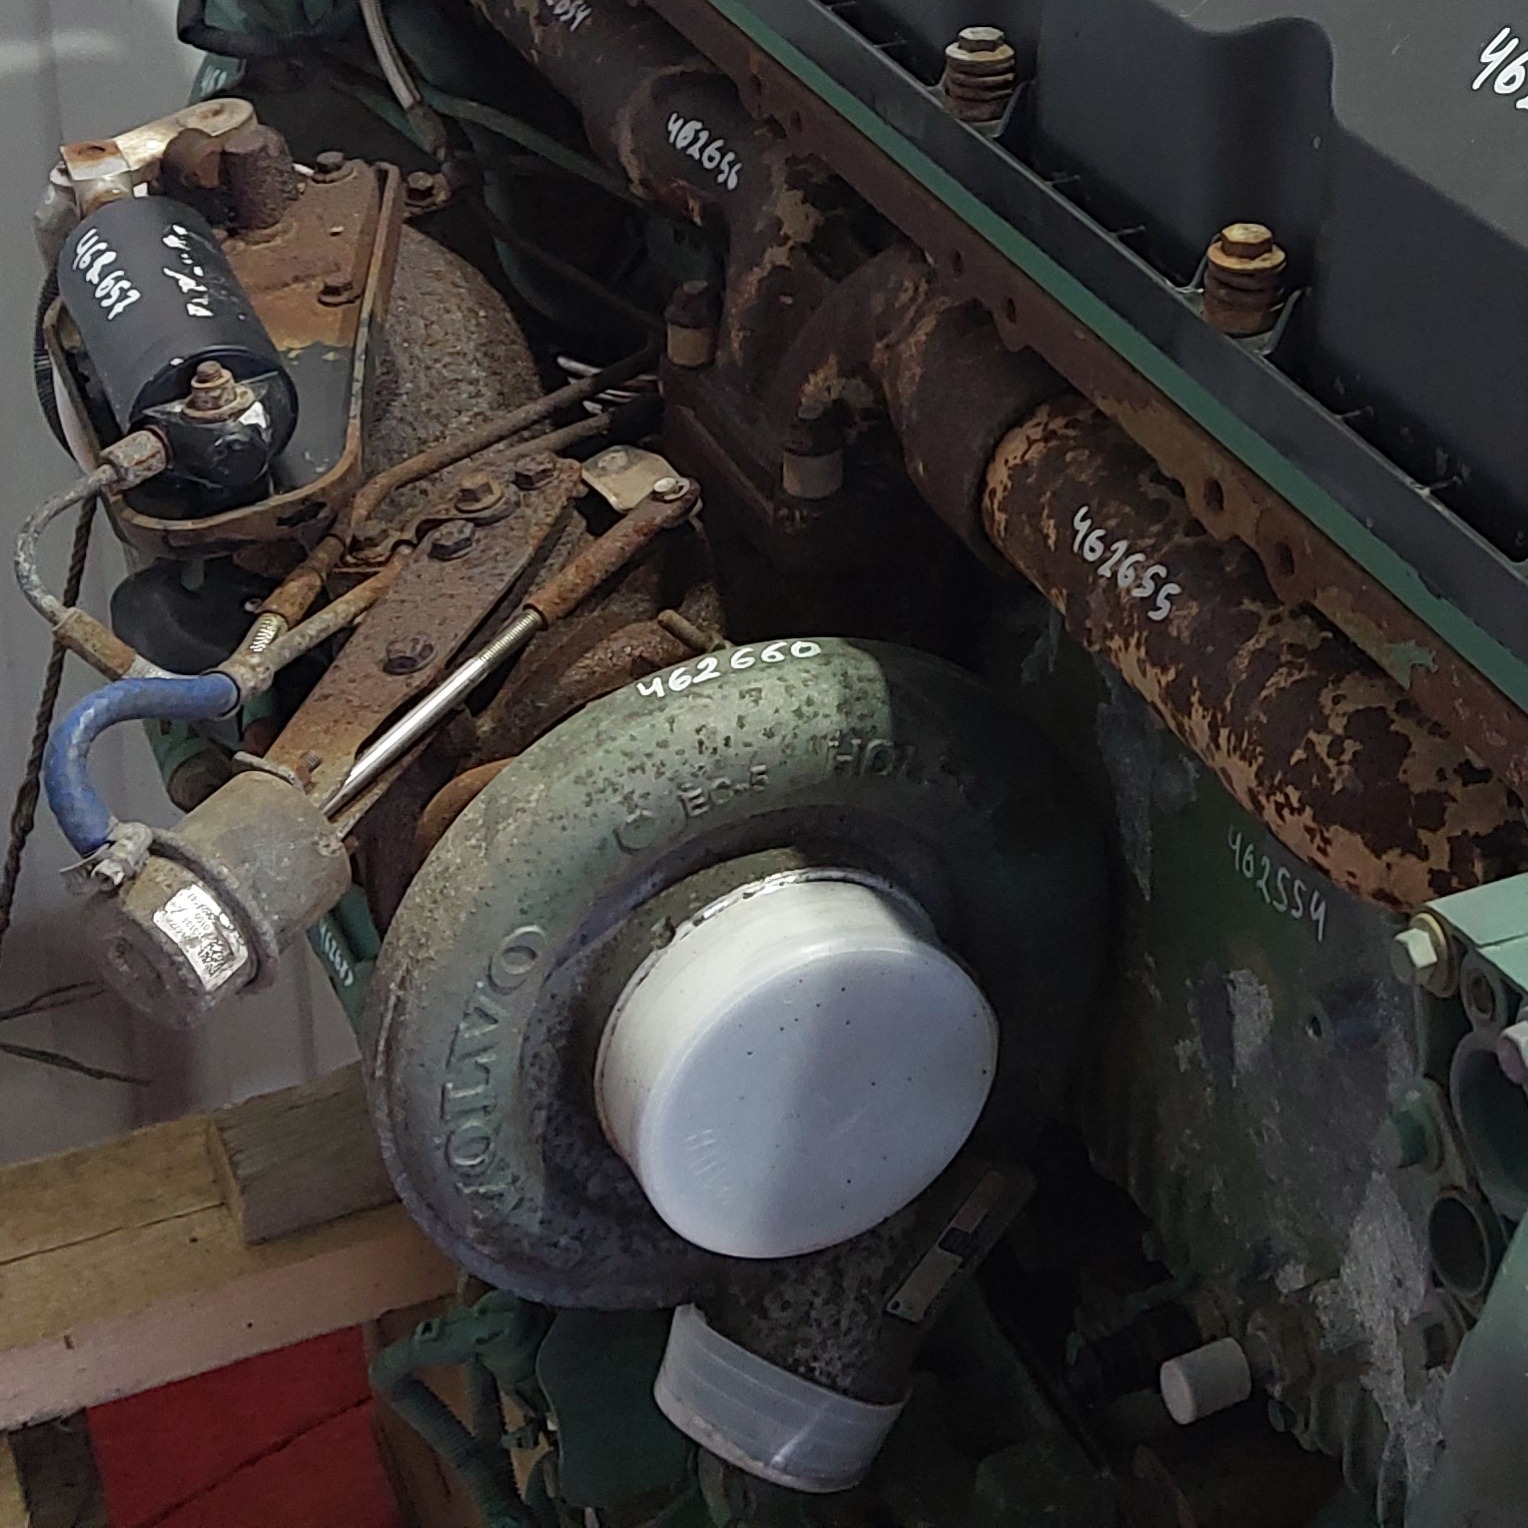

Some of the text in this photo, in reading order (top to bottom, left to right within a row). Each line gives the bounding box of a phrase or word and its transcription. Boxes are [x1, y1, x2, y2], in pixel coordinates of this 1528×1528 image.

[667, 113, 743, 190] 462656
[72, 227, 142, 321] 462657
[1072, 505, 1182, 621] 462655
[636, 640, 821, 699] 462660
[1227, 824, 1326, 942] 462554
